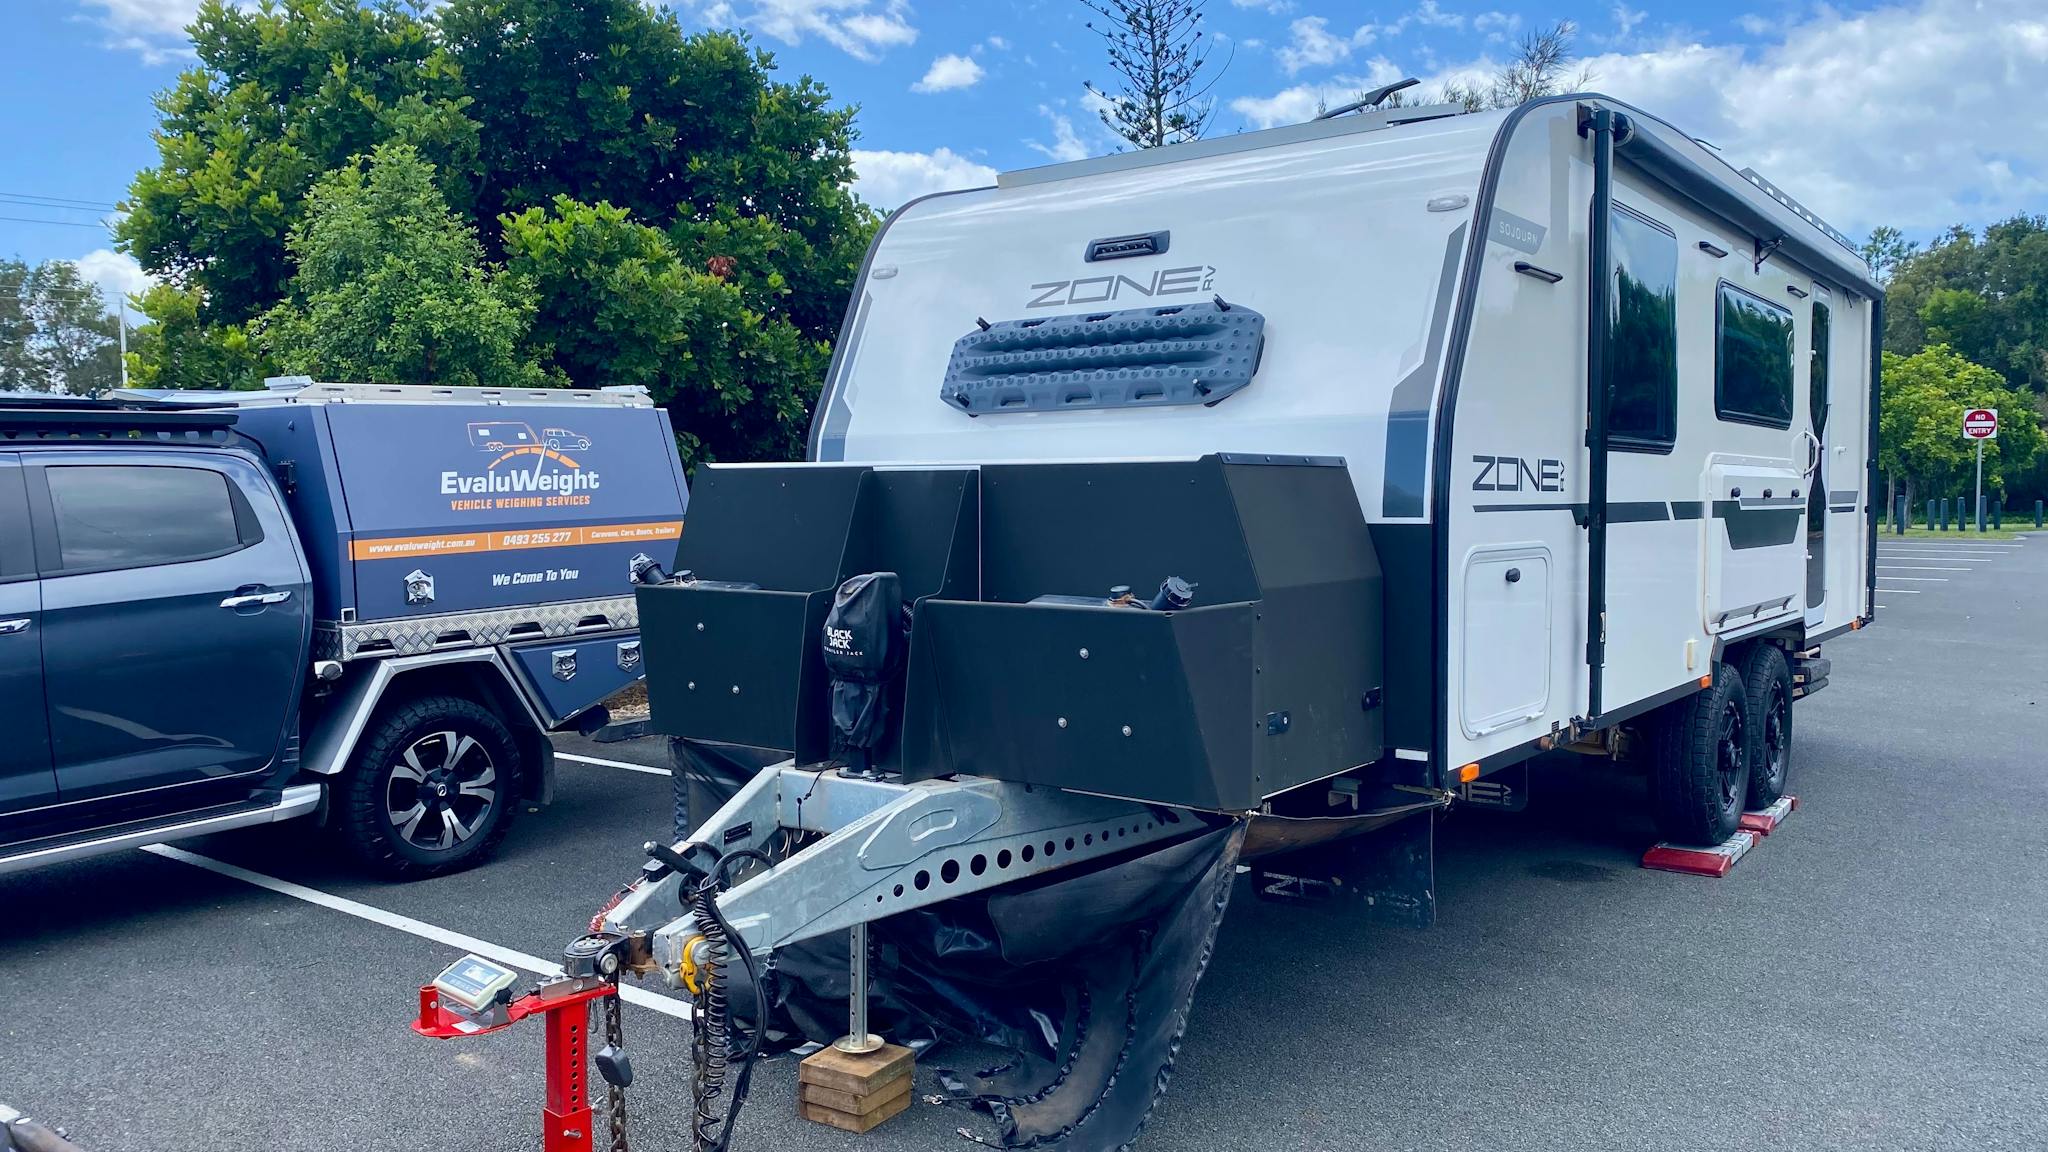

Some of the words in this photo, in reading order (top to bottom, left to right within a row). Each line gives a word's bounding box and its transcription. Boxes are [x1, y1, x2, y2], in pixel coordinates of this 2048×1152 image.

[1499, 221, 1538, 244] SOJOURN
[1026, 265, 1203, 309] ZONE
[1201, 265, 1217, 291] RV
[440, 468, 600, 496] EvaluWeight
[1472, 455, 1559, 492] ZONE
[451, 499, 492, 511] VEHICLE
[496, 497, 543, 509] WEIGHING
[546, 495, 590, 507] SERVICES
[369, 538, 475, 553] www.evaluweight.com.au
[503, 534, 529, 546] 0493
[531, 532, 550, 544] 255
[552, 531, 571, 543] 277
[492, 573, 510, 586] We
[512, 570, 543, 585] Come
[546, 569, 557, 581] To
[560, 568, 579, 580] You
[827, 626, 853, 640] BLACK
[829, 637, 850, 649] JACK
